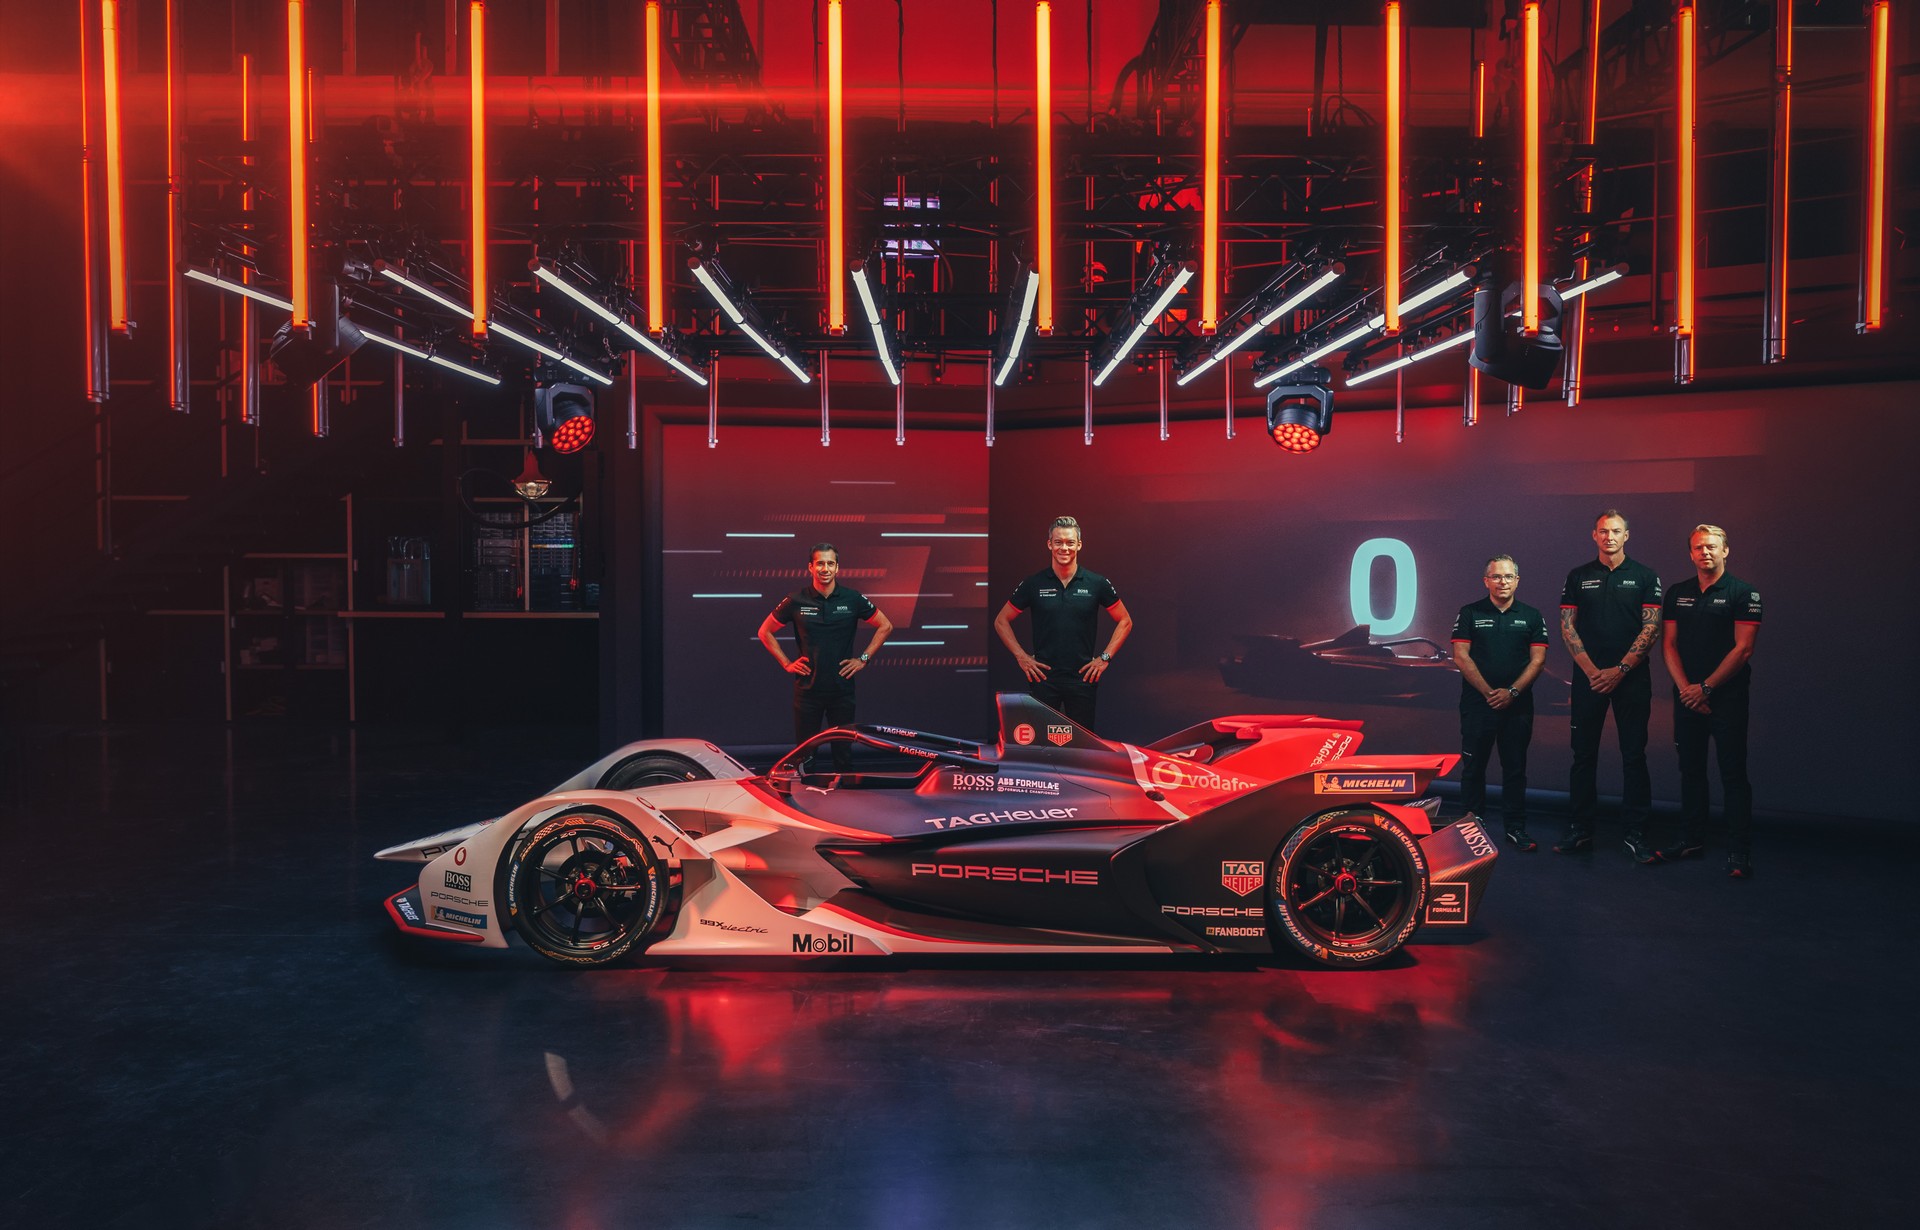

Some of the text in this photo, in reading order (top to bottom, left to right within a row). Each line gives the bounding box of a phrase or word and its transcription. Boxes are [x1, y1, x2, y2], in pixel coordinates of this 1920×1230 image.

[1350, 537, 1418, 636] 0
[1049, 726, 1071, 734] TAG
[1049, 734, 1071, 746] HEUER
[952, 774, 995, 787] BOSS
[997, 777, 1014, 786] ABB
[1342, 779, 1407, 788] MICHELIN
[1456, 821, 1494, 857] ANSYS
[1389, 825, 1425, 871] MICHELIN
[911, 863, 1099, 885] PORSCHE
[1225, 863, 1261, 875] TAG
[446, 871, 470, 887] BOSS
[509, 864, 519, 902] MICHELIN
[1224, 877, 1262, 894] HEUER
[431, 891, 489, 907] PORSCHE
[646, 880, 658, 919] MICHELIN
[445, 912, 482, 925] MICHELIN
[1161, 905, 1264, 917] PORSCHE
[720, 922, 769, 934] electric
[1215, 927, 1265, 937] FANBOOST
[1278, 903, 1313, 949] MICHELIN
[792, 933, 854, 953] Mobil
